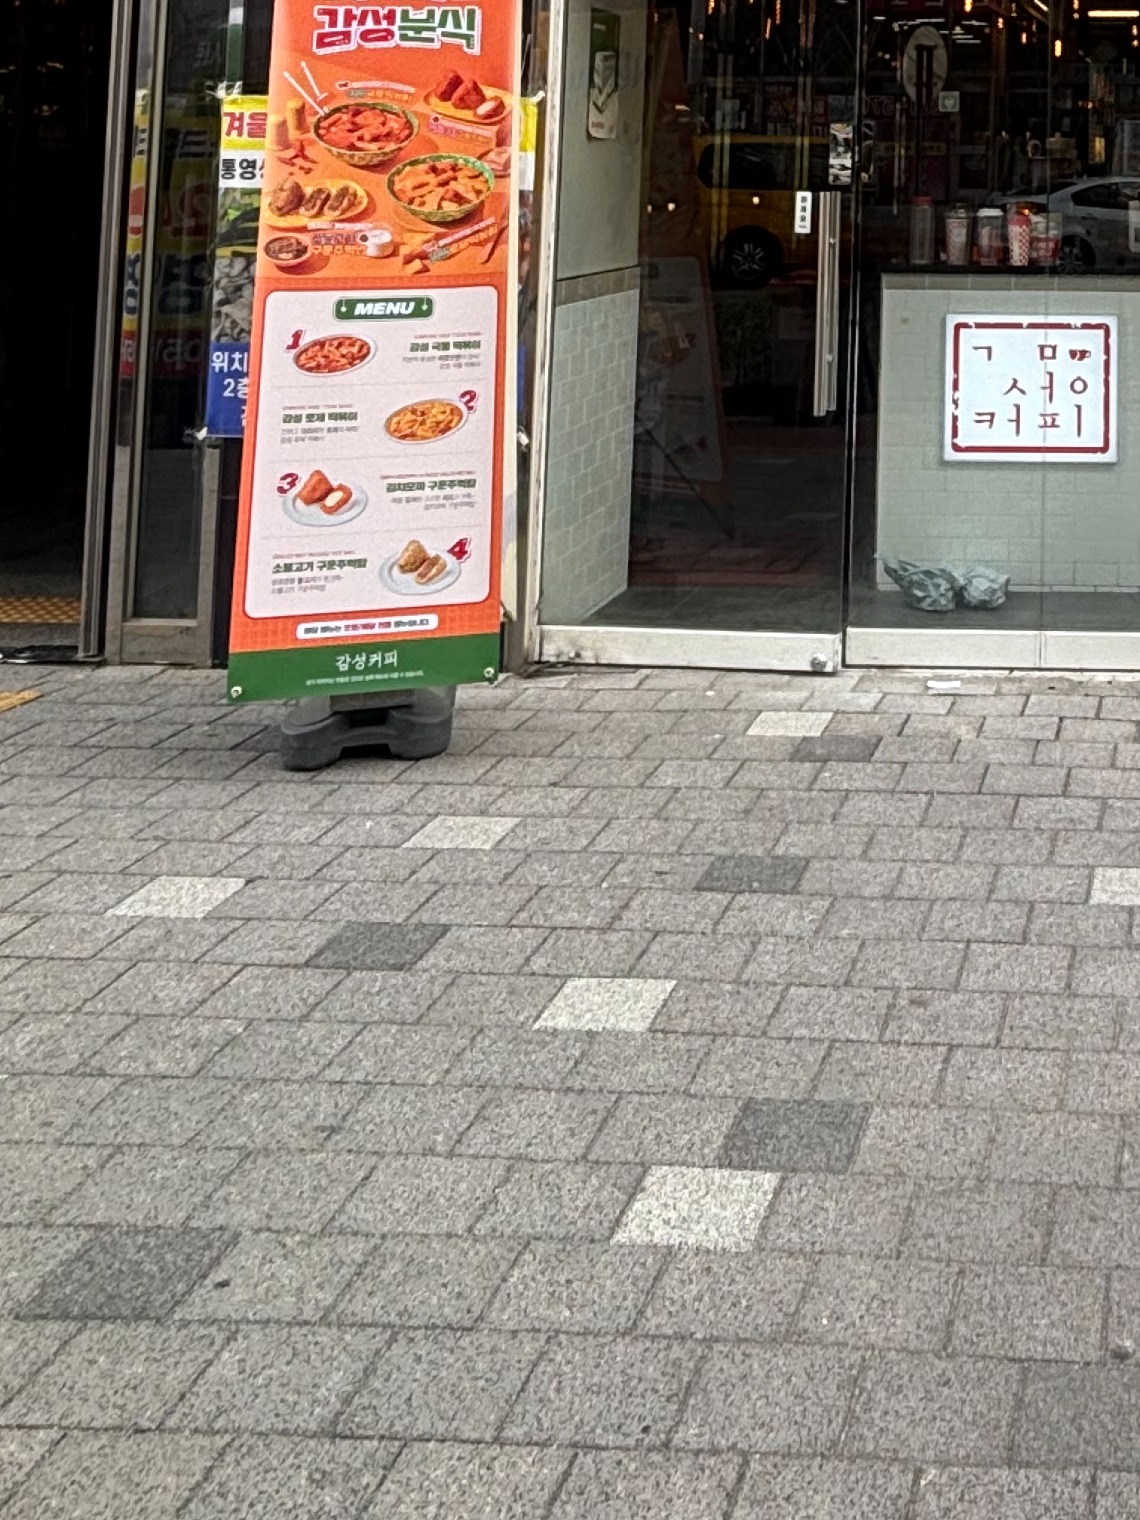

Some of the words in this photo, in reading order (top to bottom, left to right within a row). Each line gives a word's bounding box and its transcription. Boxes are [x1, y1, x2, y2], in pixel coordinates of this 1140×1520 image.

[313, 6, 482, 54] 감성분식
[353, 301, 415, 317] MENU
[459, 390, 478, 412] 2
[277, 472, 300, 494] 3
[450, 538, 471, 562] 4
[336, 650, 398, 672] 감성커피
